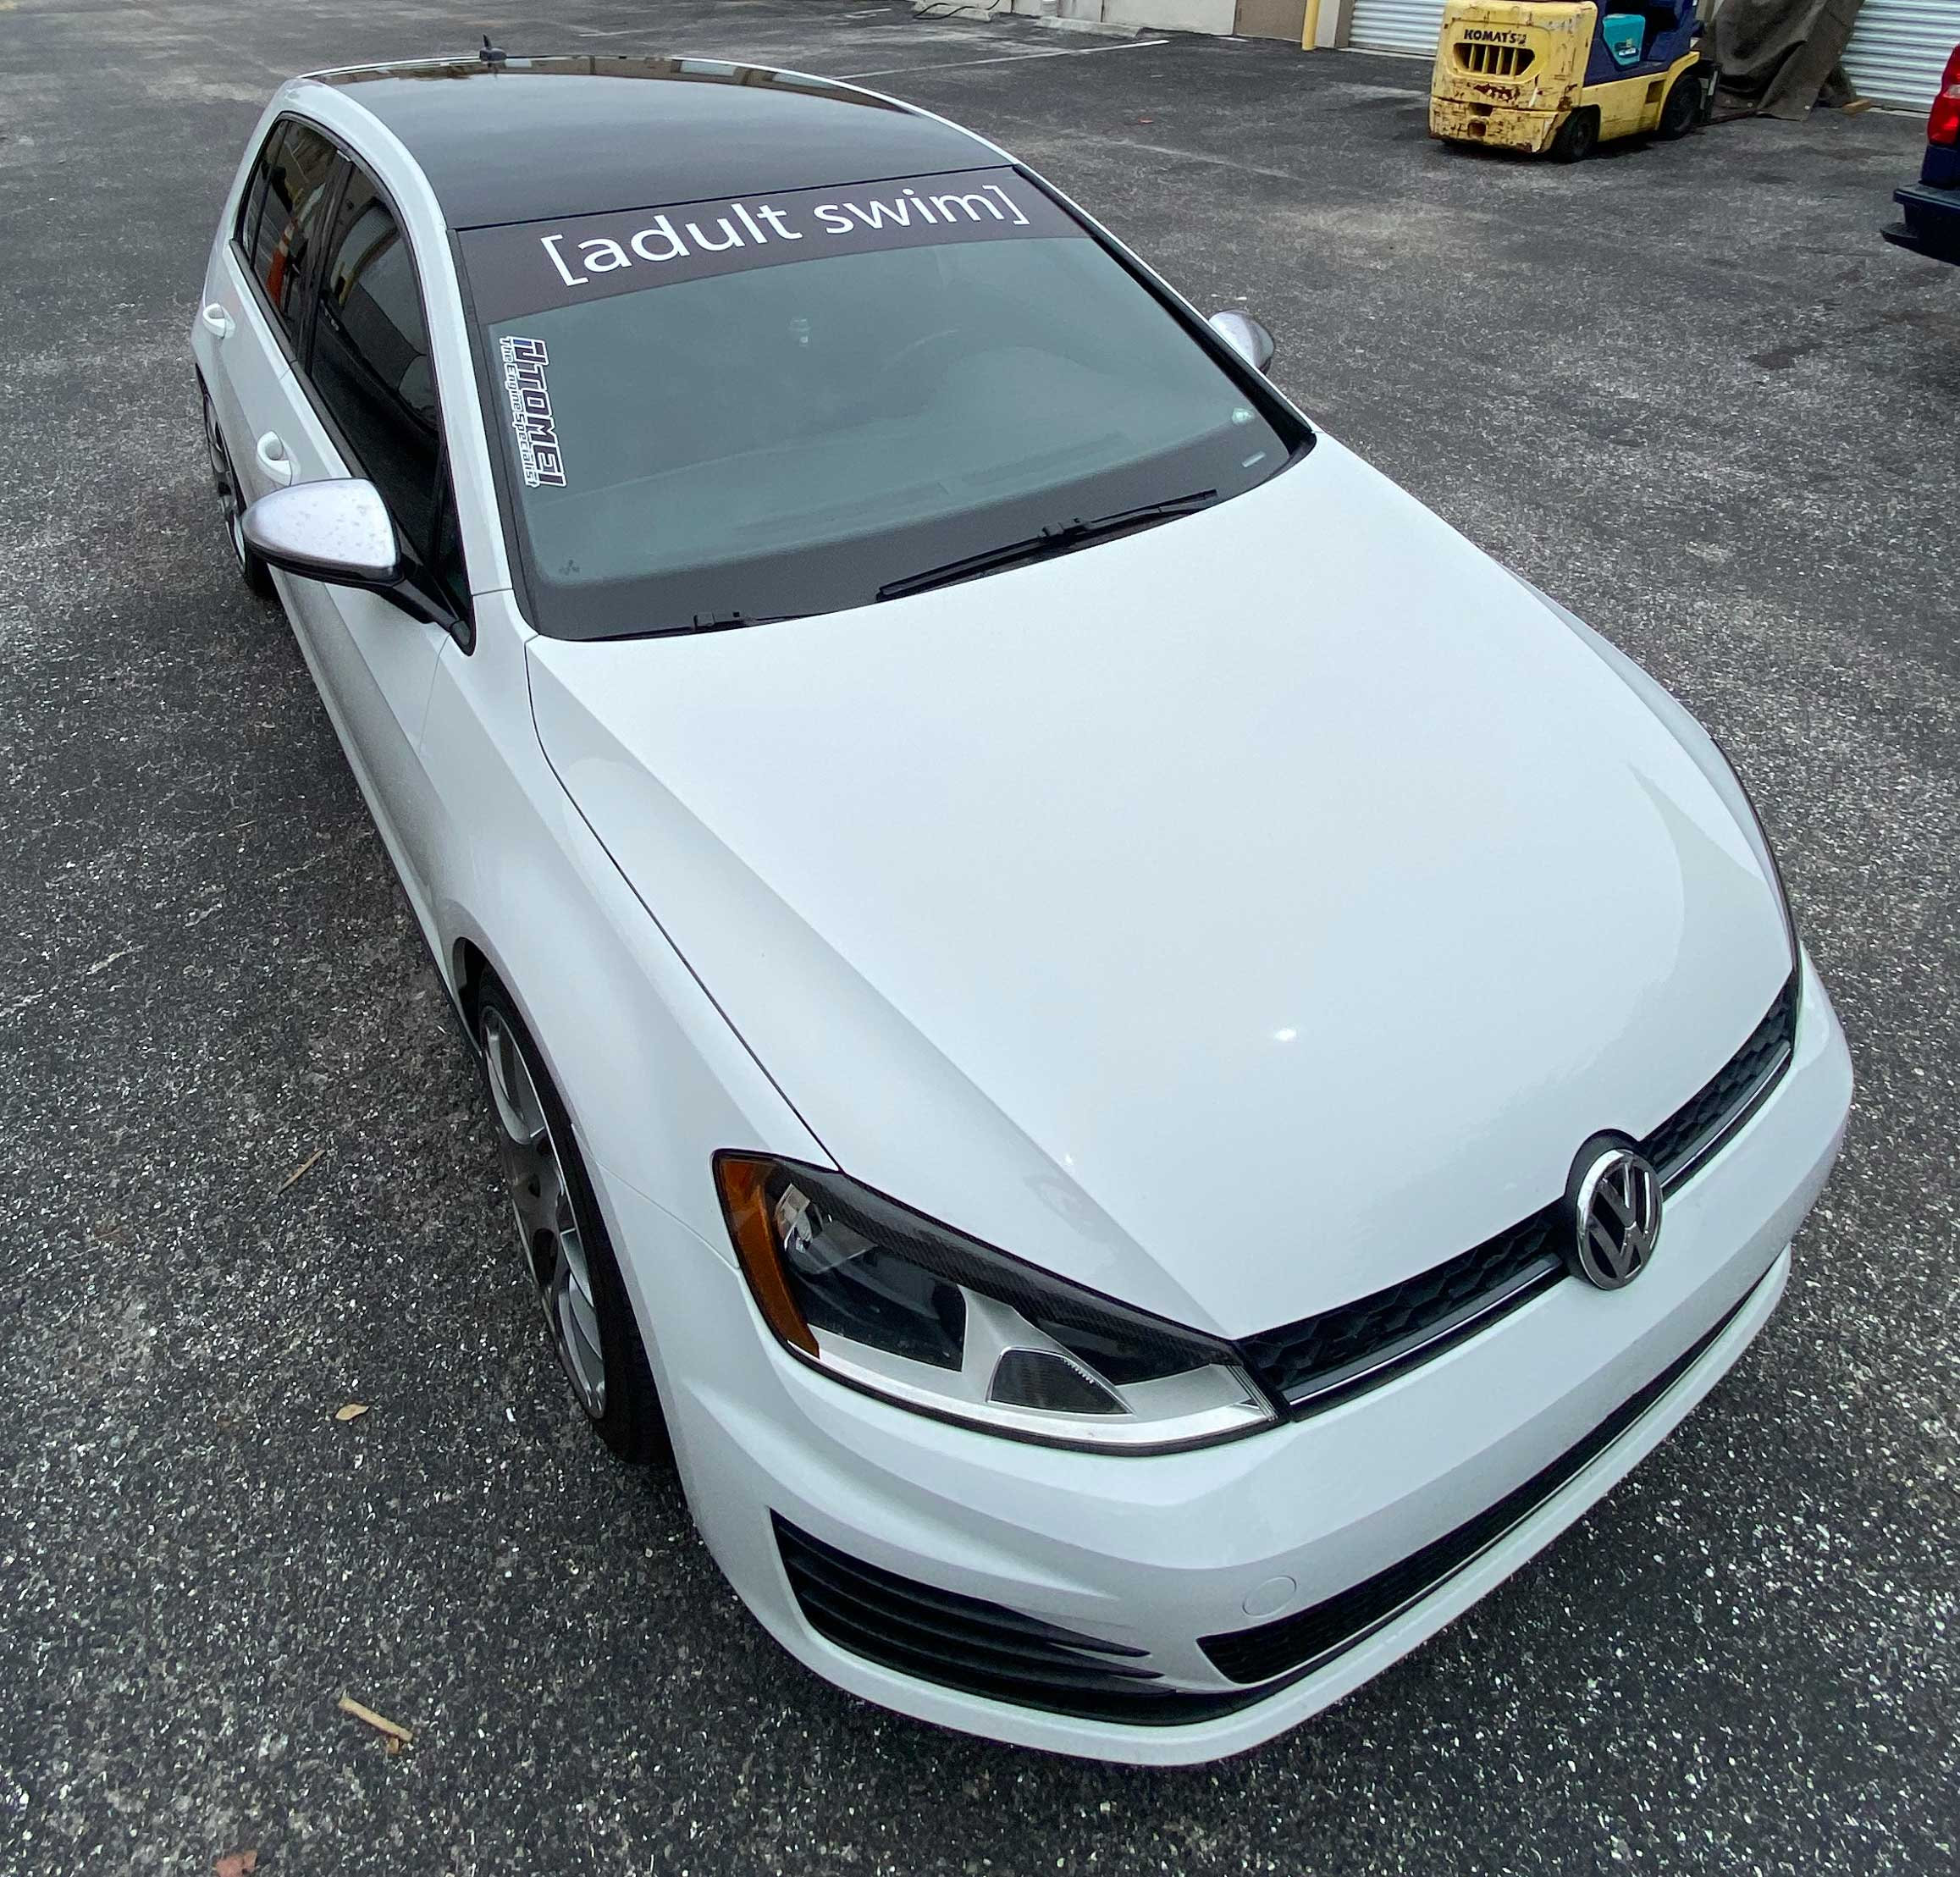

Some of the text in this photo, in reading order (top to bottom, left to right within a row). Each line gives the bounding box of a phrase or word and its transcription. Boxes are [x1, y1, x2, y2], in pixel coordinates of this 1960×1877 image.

[540, 184, 1030, 287] [adult swim]
[501, 339, 538, 486] The Engine Specialist
[1582, 1154, 1657, 1282] VW
